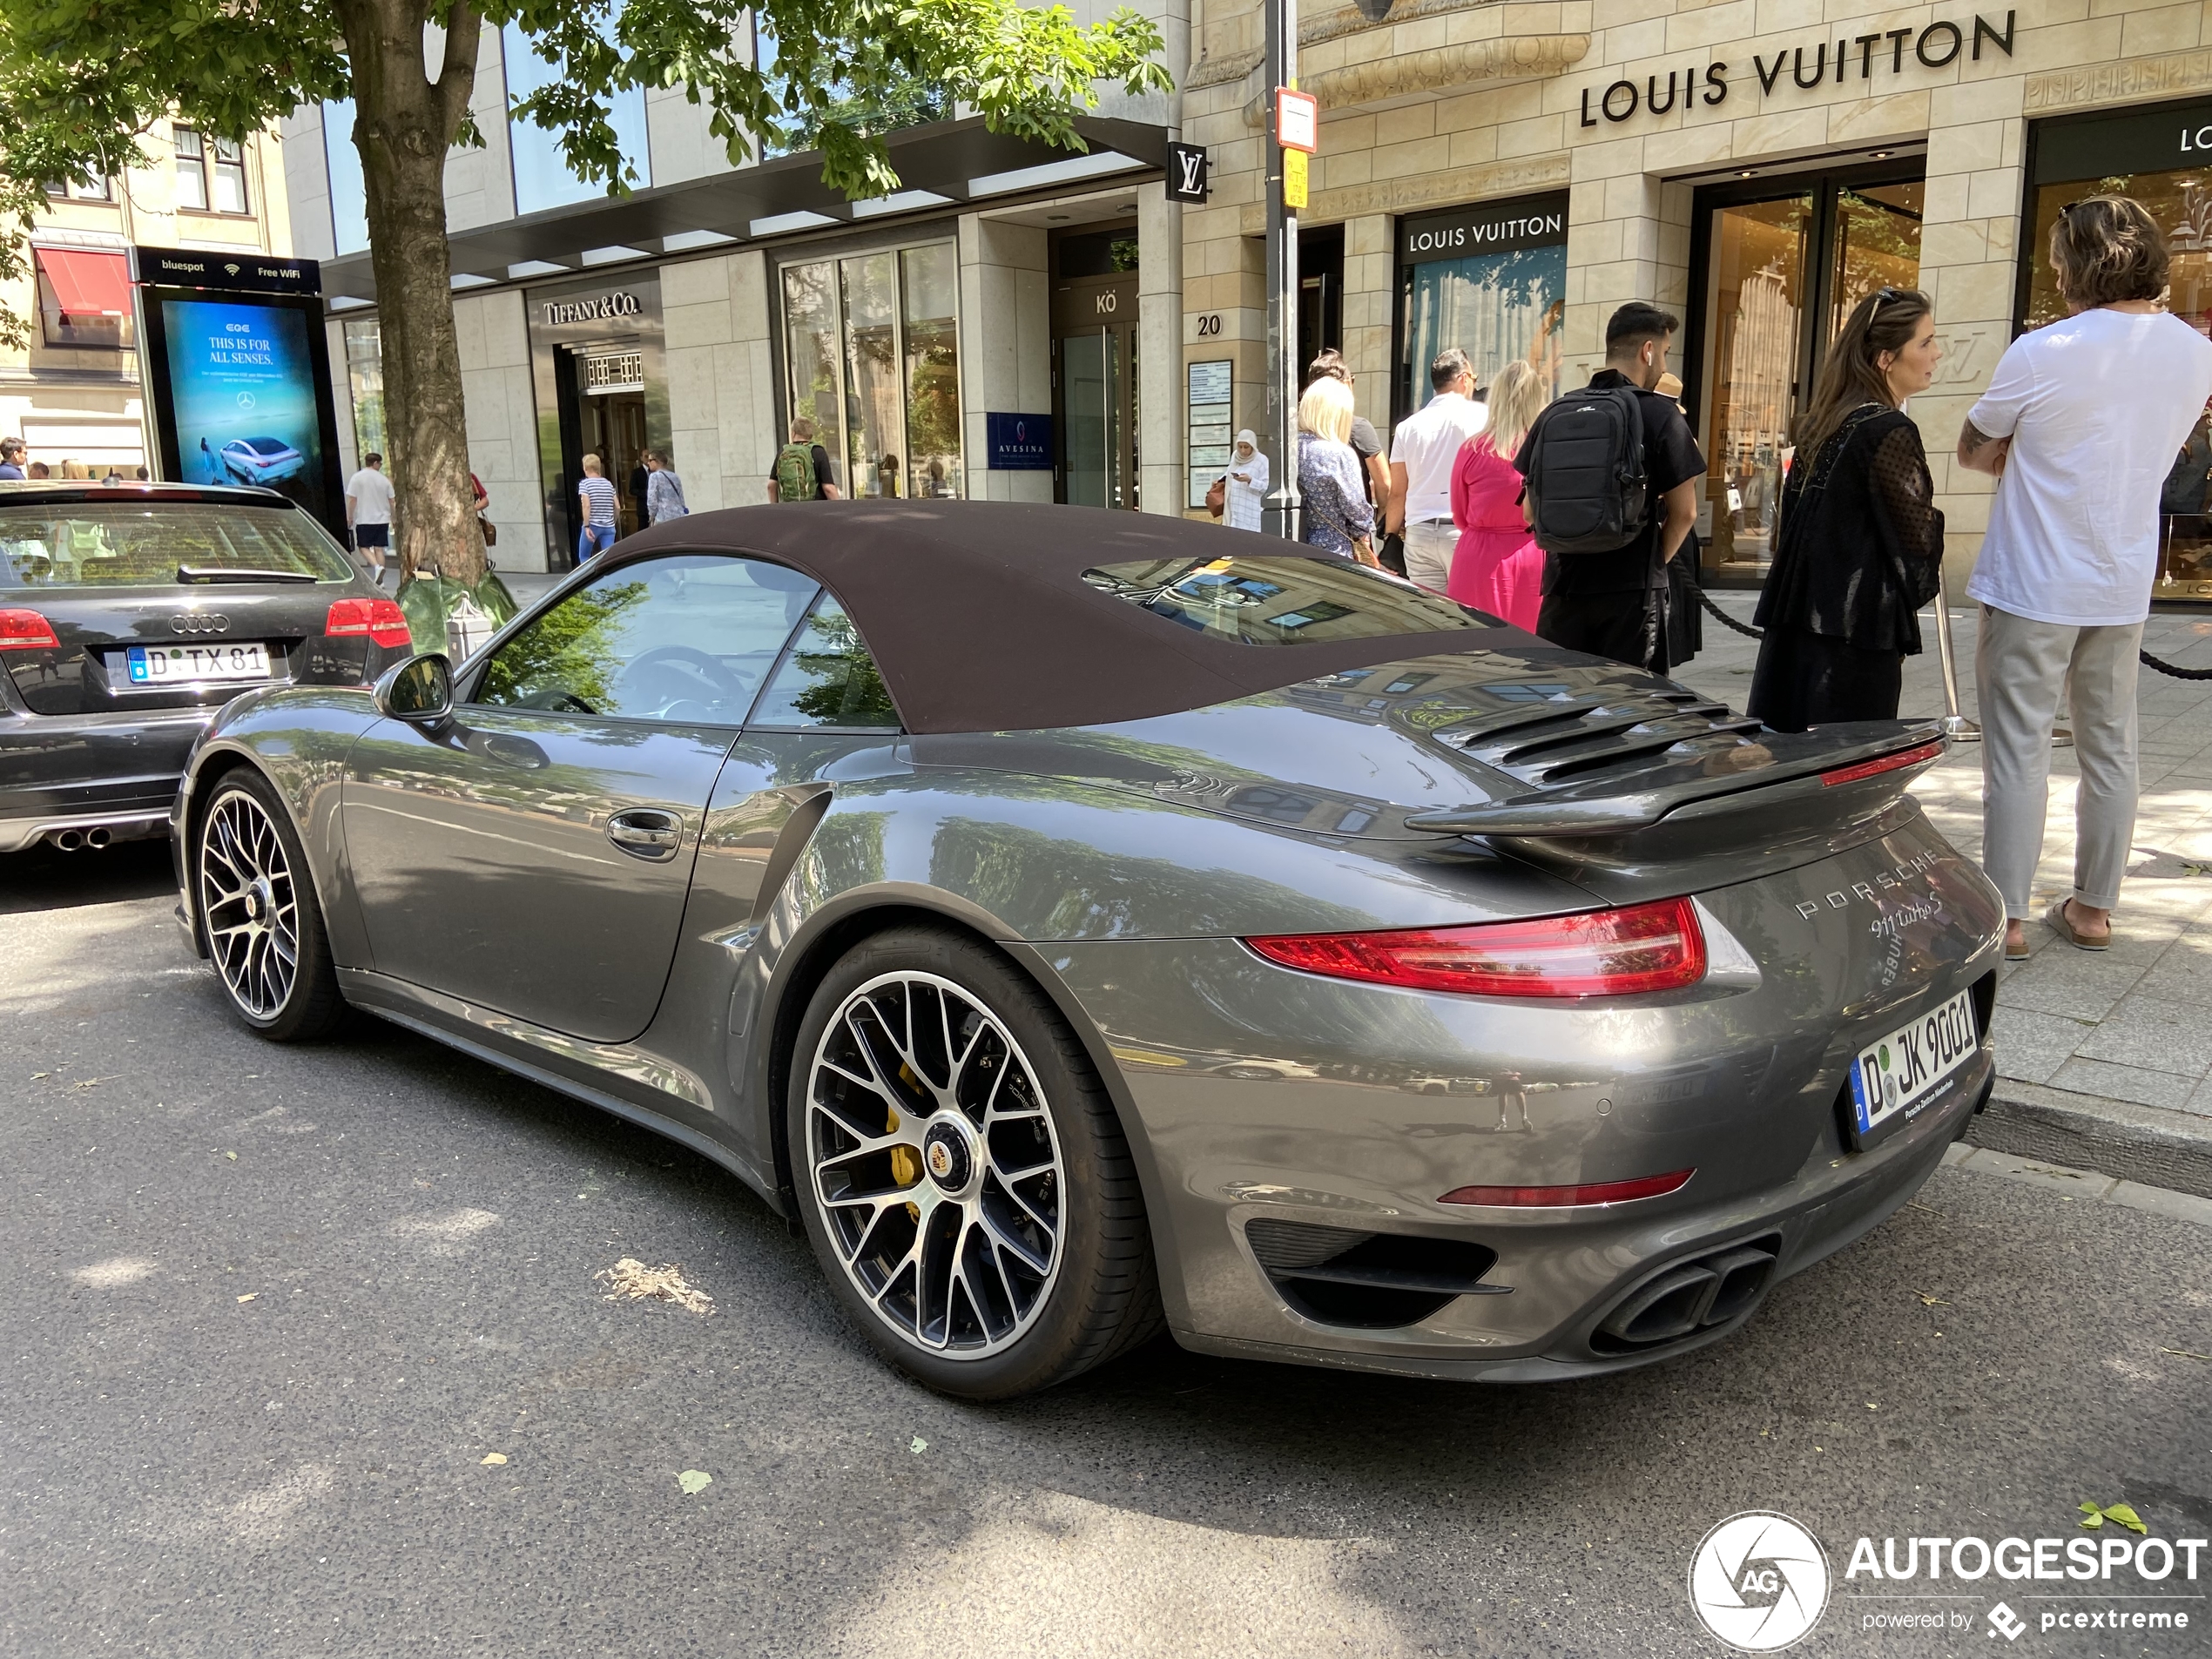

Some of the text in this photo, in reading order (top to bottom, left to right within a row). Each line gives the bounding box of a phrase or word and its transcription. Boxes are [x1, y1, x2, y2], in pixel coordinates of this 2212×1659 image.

[1581, 10, 2016, 128] LOUIS VUITTON
[1177, 149, 1203, 195] LV
[1409, 213, 1562, 253] LOUIS VUITTON
[162, 260, 205, 273] bluespot
[258, 267, 301, 279] Free WiFi
[1096, 289, 1117, 314] KÖ
[226, 323, 251, 333] EQE
[1197, 314, 1223, 336] 20
[208, 337, 271, 352] THIS IS FOR
[209, 351, 273, 366] ALL SENSES.
[148, 647, 264, 676] D TX 81
[1794, 849, 1940, 921] PORSCHE
[1870, 915, 1896, 939] 911
[1929, 891, 1943, 915] S
[1862, 995, 1973, 1117] D JK 9001
[1856, 1103, 1864, 1122] D
[1905, 1103, 1921, 1121] Porsche
